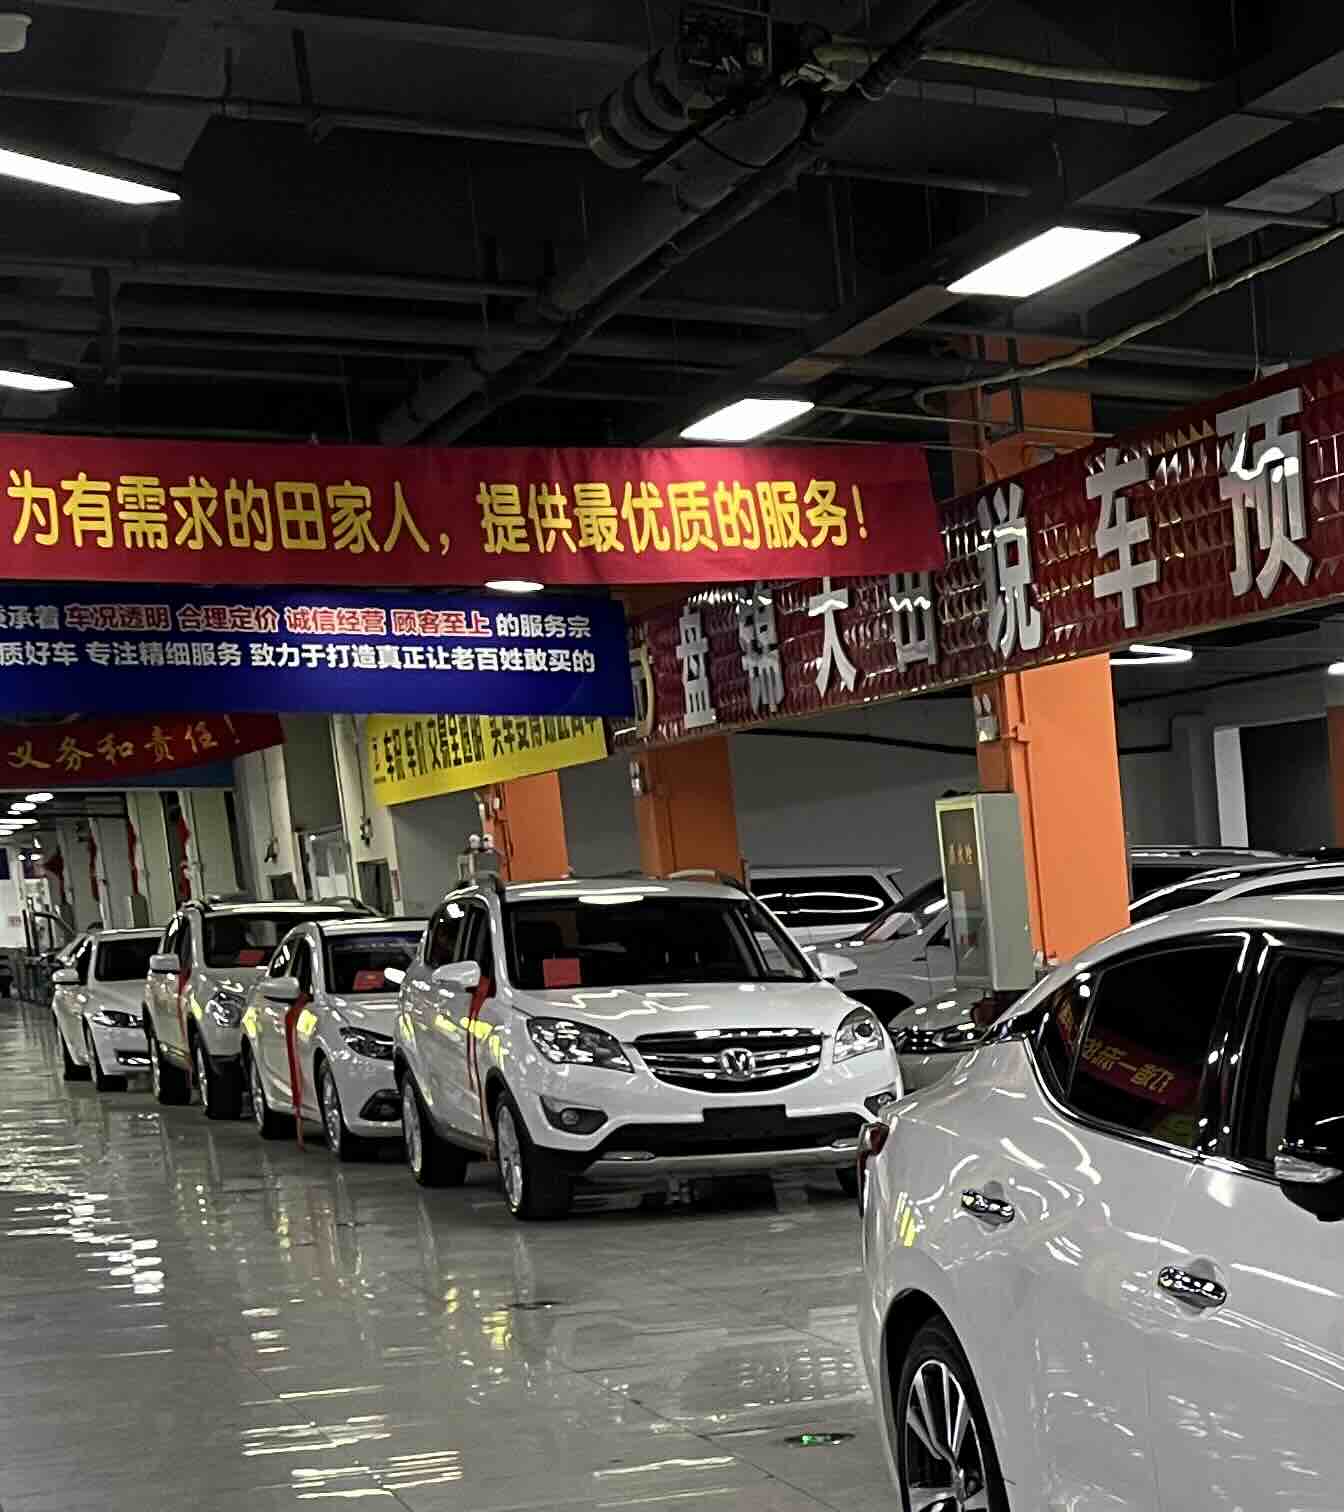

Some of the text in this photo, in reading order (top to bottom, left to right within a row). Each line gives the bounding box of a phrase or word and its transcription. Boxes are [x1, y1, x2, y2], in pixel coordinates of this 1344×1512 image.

[64, 603, 172, 632] 车况透明
[176, 604, 279, 633] 合理定价
[284, 606, 386, 636] 诚信经营
[391, 609, 492, 637] 顾客至上
[496, 613, 591, 638] 的服务宗
[85, 641, 242, 668] 专注精细服务
[249, 642, 596, 674] 致力于打造真正让老百姓敢买的
